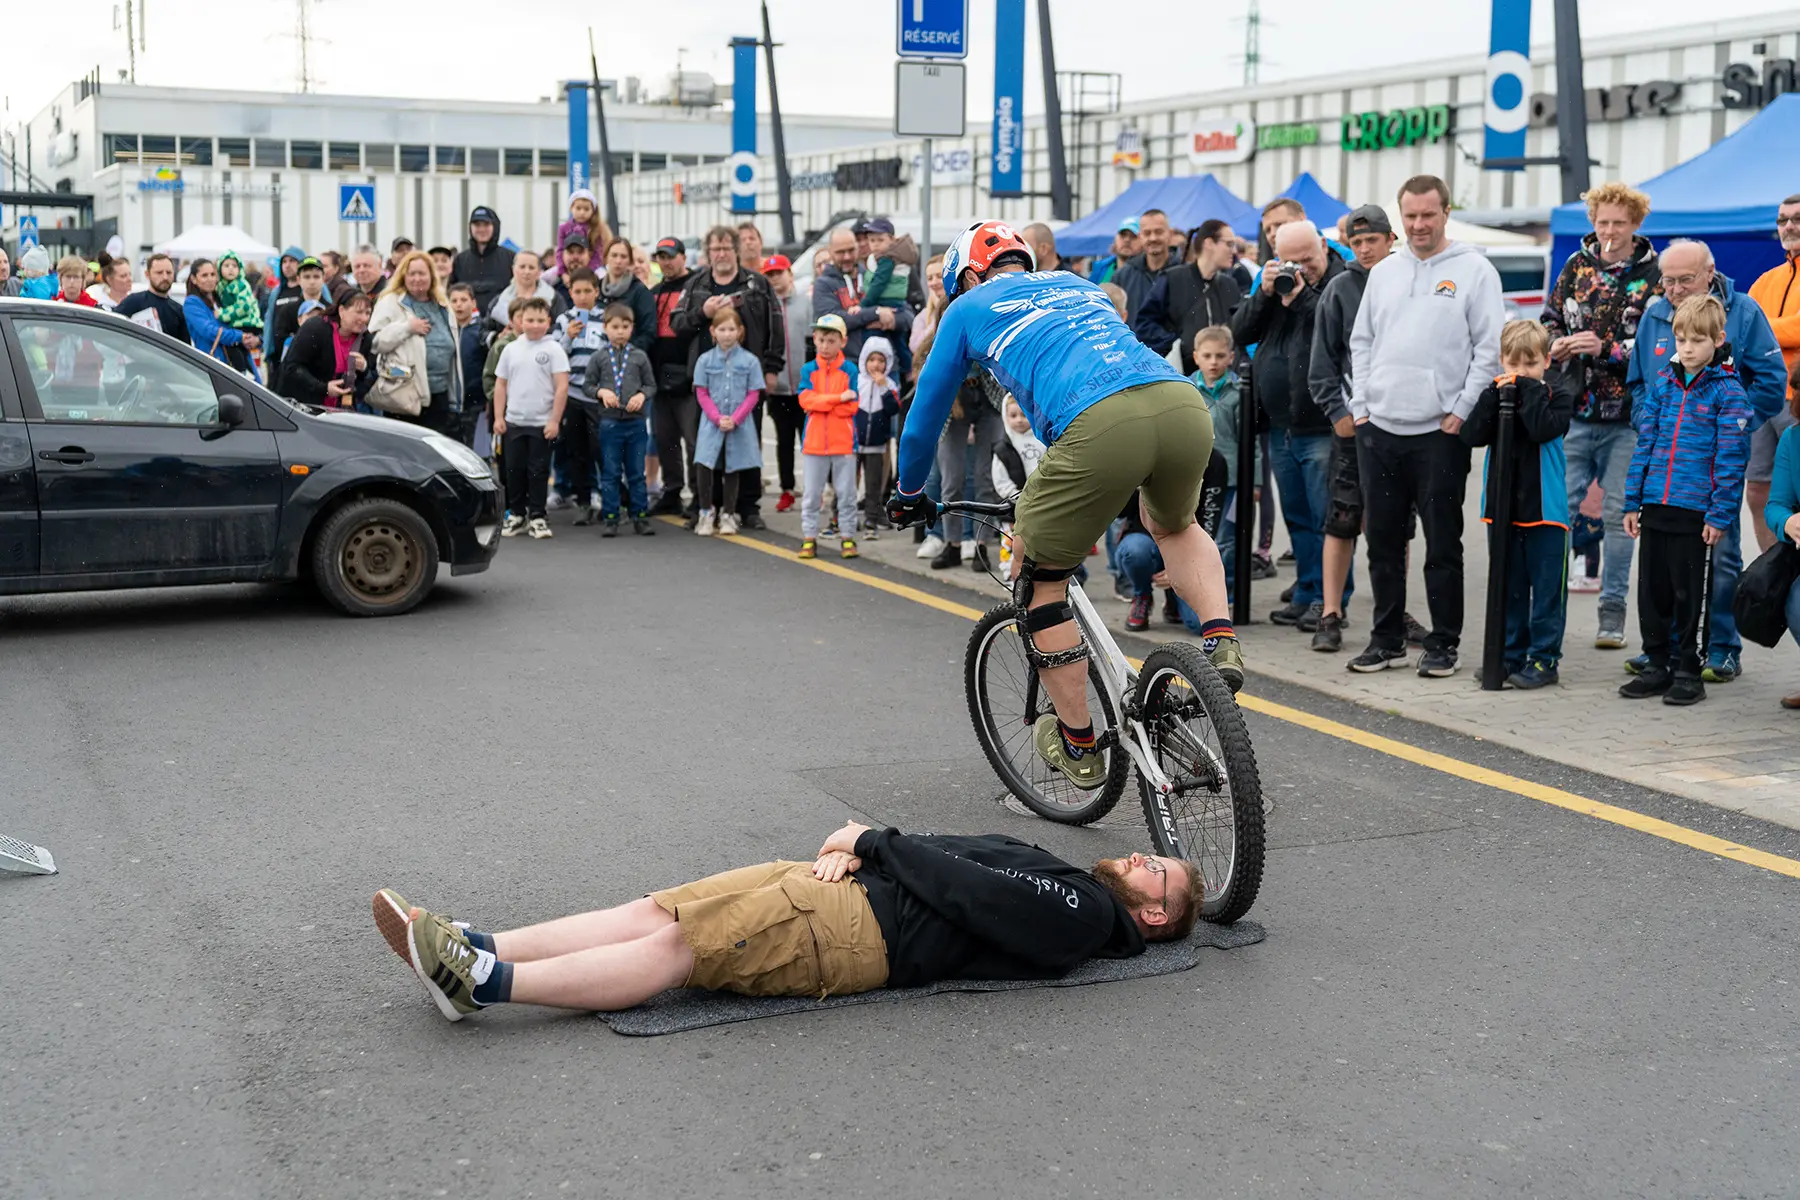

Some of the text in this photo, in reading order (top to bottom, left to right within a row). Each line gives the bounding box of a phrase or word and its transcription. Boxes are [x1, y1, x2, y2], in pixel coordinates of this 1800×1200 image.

[904, 28, 961, 45] RÉSERVÉ
[995, 96, 1014, 174] olympia
[1341, 104, 1452, 152] CROPP
[912, 150, 969, 176] FCHER
[1085, 367, 1124, 391] SLEEP
[1132, 360, 1154, 373] EAT
[1155, 788, 1177, 845] TRIA
